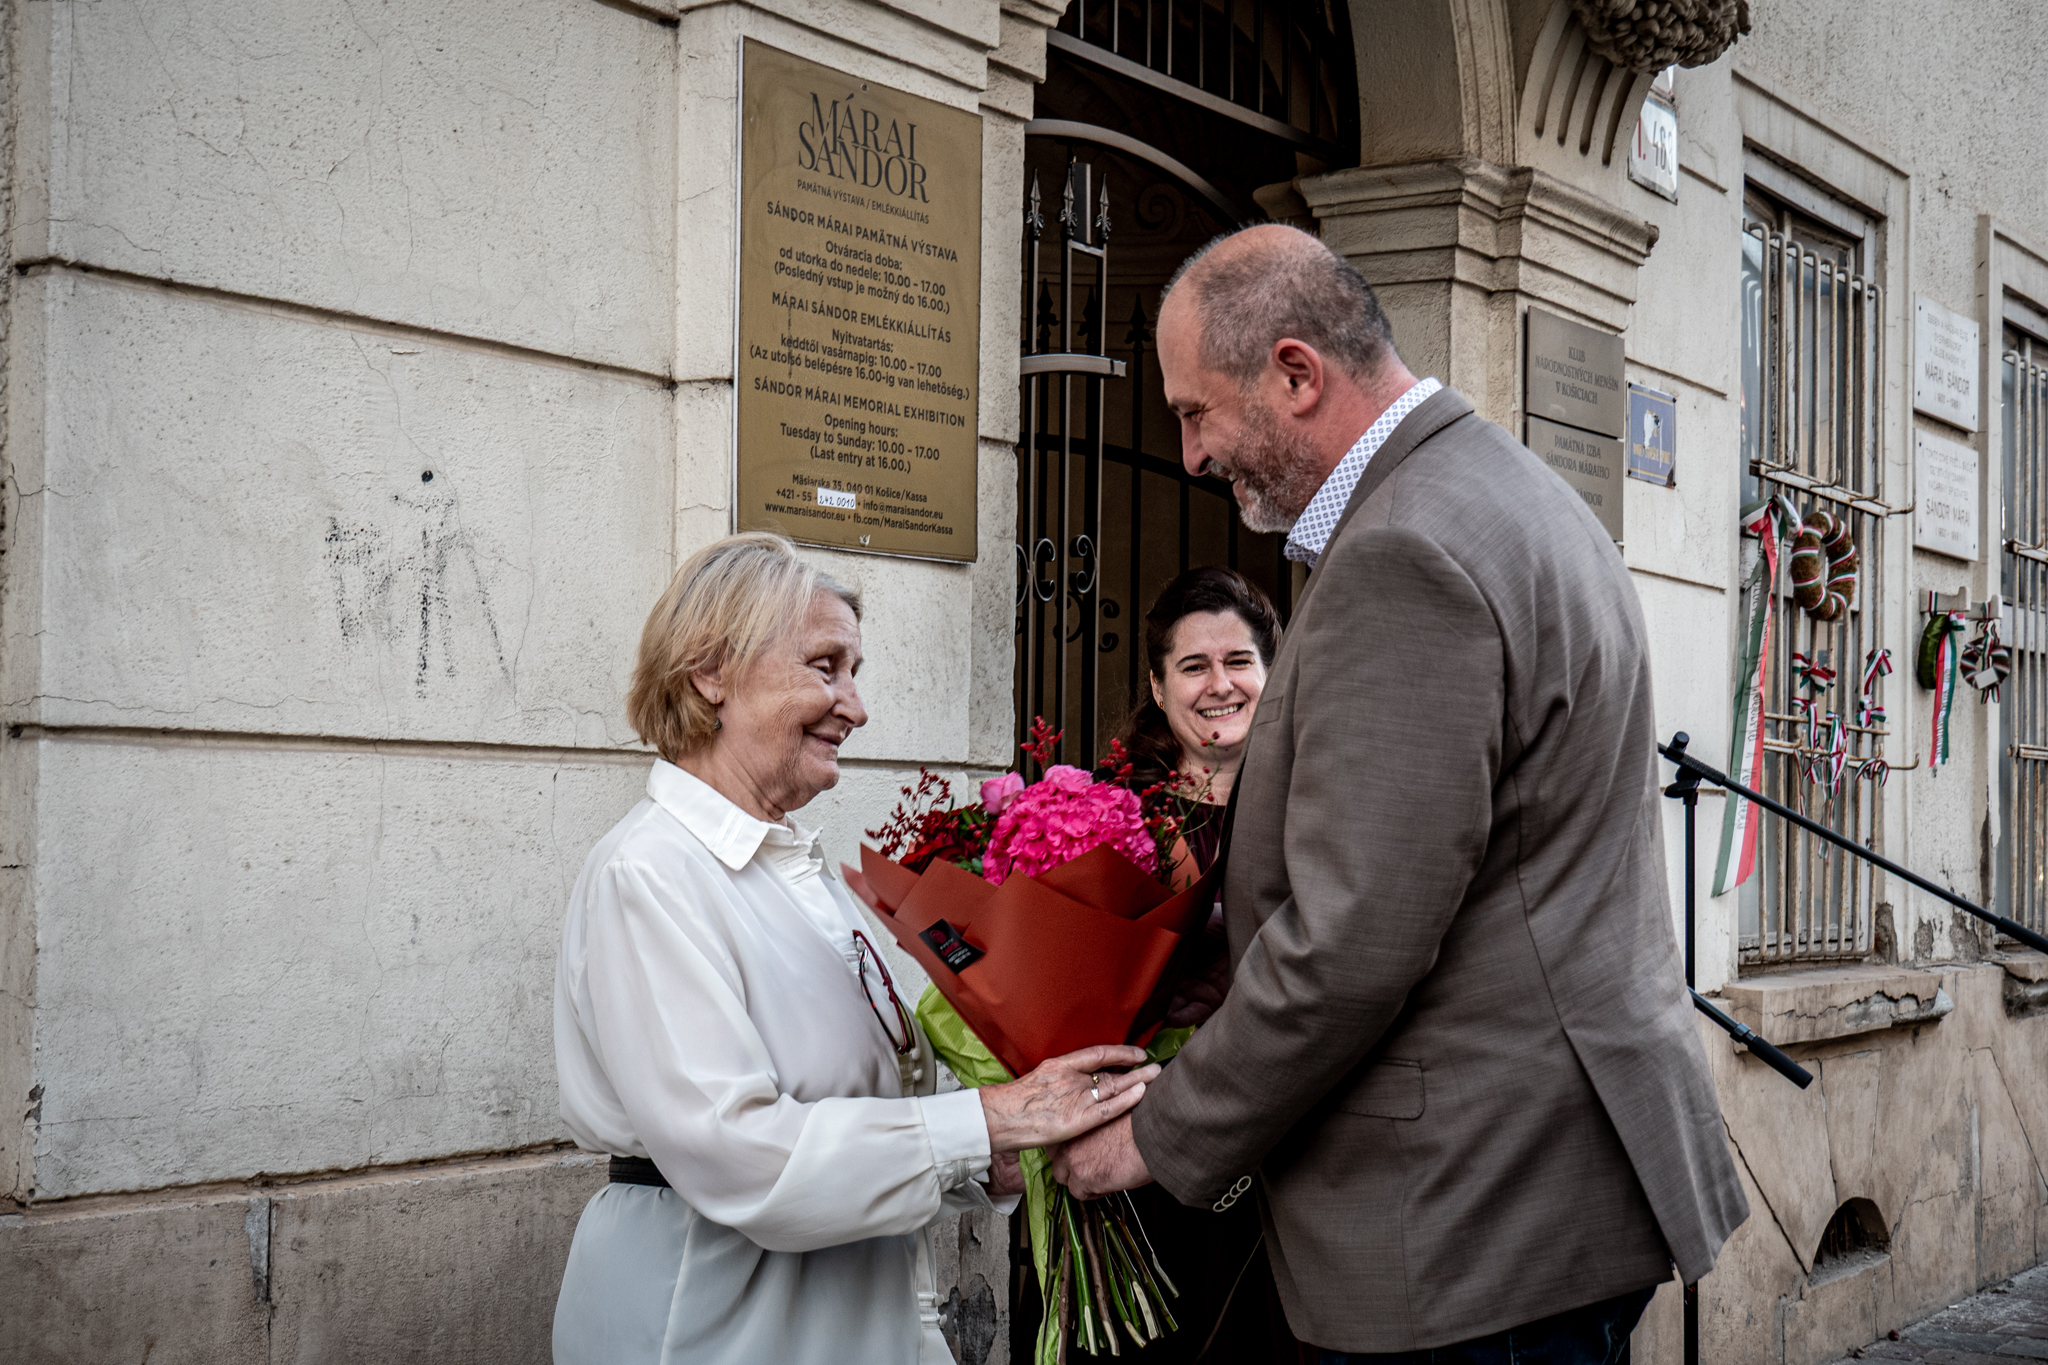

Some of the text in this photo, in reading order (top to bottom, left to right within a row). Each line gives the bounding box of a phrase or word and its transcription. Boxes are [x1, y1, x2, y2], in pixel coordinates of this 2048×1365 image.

[810, 91, 917, 162] MÁRAI
[798, 120, 930, 204] SÁNDOR
[797, 179, 832, 198] PAMÄTNÁ
[833, 189, 865, 208] VÝSTAVA
[871, 200, 930, 224] EMLÉKKIÁLLÍTÁS
[767, 200, 958, 263] SÁNDOR MÁRAI PAMÄTNÁ VÝSTAVA
[779, 246, 793, 260] od
[795, 250, 827, 269] utorka
[830, 258, 843, 272] do
[845, 263, 881, 282] nedele:
[884, 271, 911, 288] 10.00
[920, 280, 946, 297] 17.00
[825, 240, 903, 271] Otváracia doba:
[774, 261, 951, 315] (Posledný vstup je možný do 16.00.)
[772, 291, 951, 343] MÁRAI SÁNDOR EMLÉKKIÁLLÍTÁS
[781, 333, 819, 354] keddtől
[821, 344, 878, 367] vasárnapig:
[880, 355, 907, 371] 10.00
[917, 362, 942, 378] 17.00
[832, 328, 894, 353] Nyitvatartás:
[1568, 346, 1586, 363] KLUB
[750, 344, 970, 401] (Az utolsó belépésre 16.00-ig van lehetőség.)
[1535, 354, 1593, 384] NÁRODNOSTNÝCH
[754, 375, 965, 427] SÁNDOR MÁRAI MEMORIAL EXHIBITION
[1555, 381, 1598, 405] V KOŠICIACH
[780, 422, 821, 443] Tuesday
[823, 430, 834, 444] to
[836, 433, 875, 451] Sunday:
[877, 439, 905, 454] 10.00
[914, 446, 940, 460] 17.00
[824, 413, 898, 438] Opening hours:
[810, 445, 911, 474] (Last entry at 16.00.)
[1545, 450, 1610, 480] SÁNDORA MÁRAIHO
[1586, 444, 1601, 459] IZBA
[776, 488, 795, 500] +421
[802, 490, 812, 502] 55
[846, 482, 862, 494] 040
[864, 485, 874, 495] 01
[765, 502, 953, 535] www.maraisandor.eu fb.com/MaraiSandorKassa
